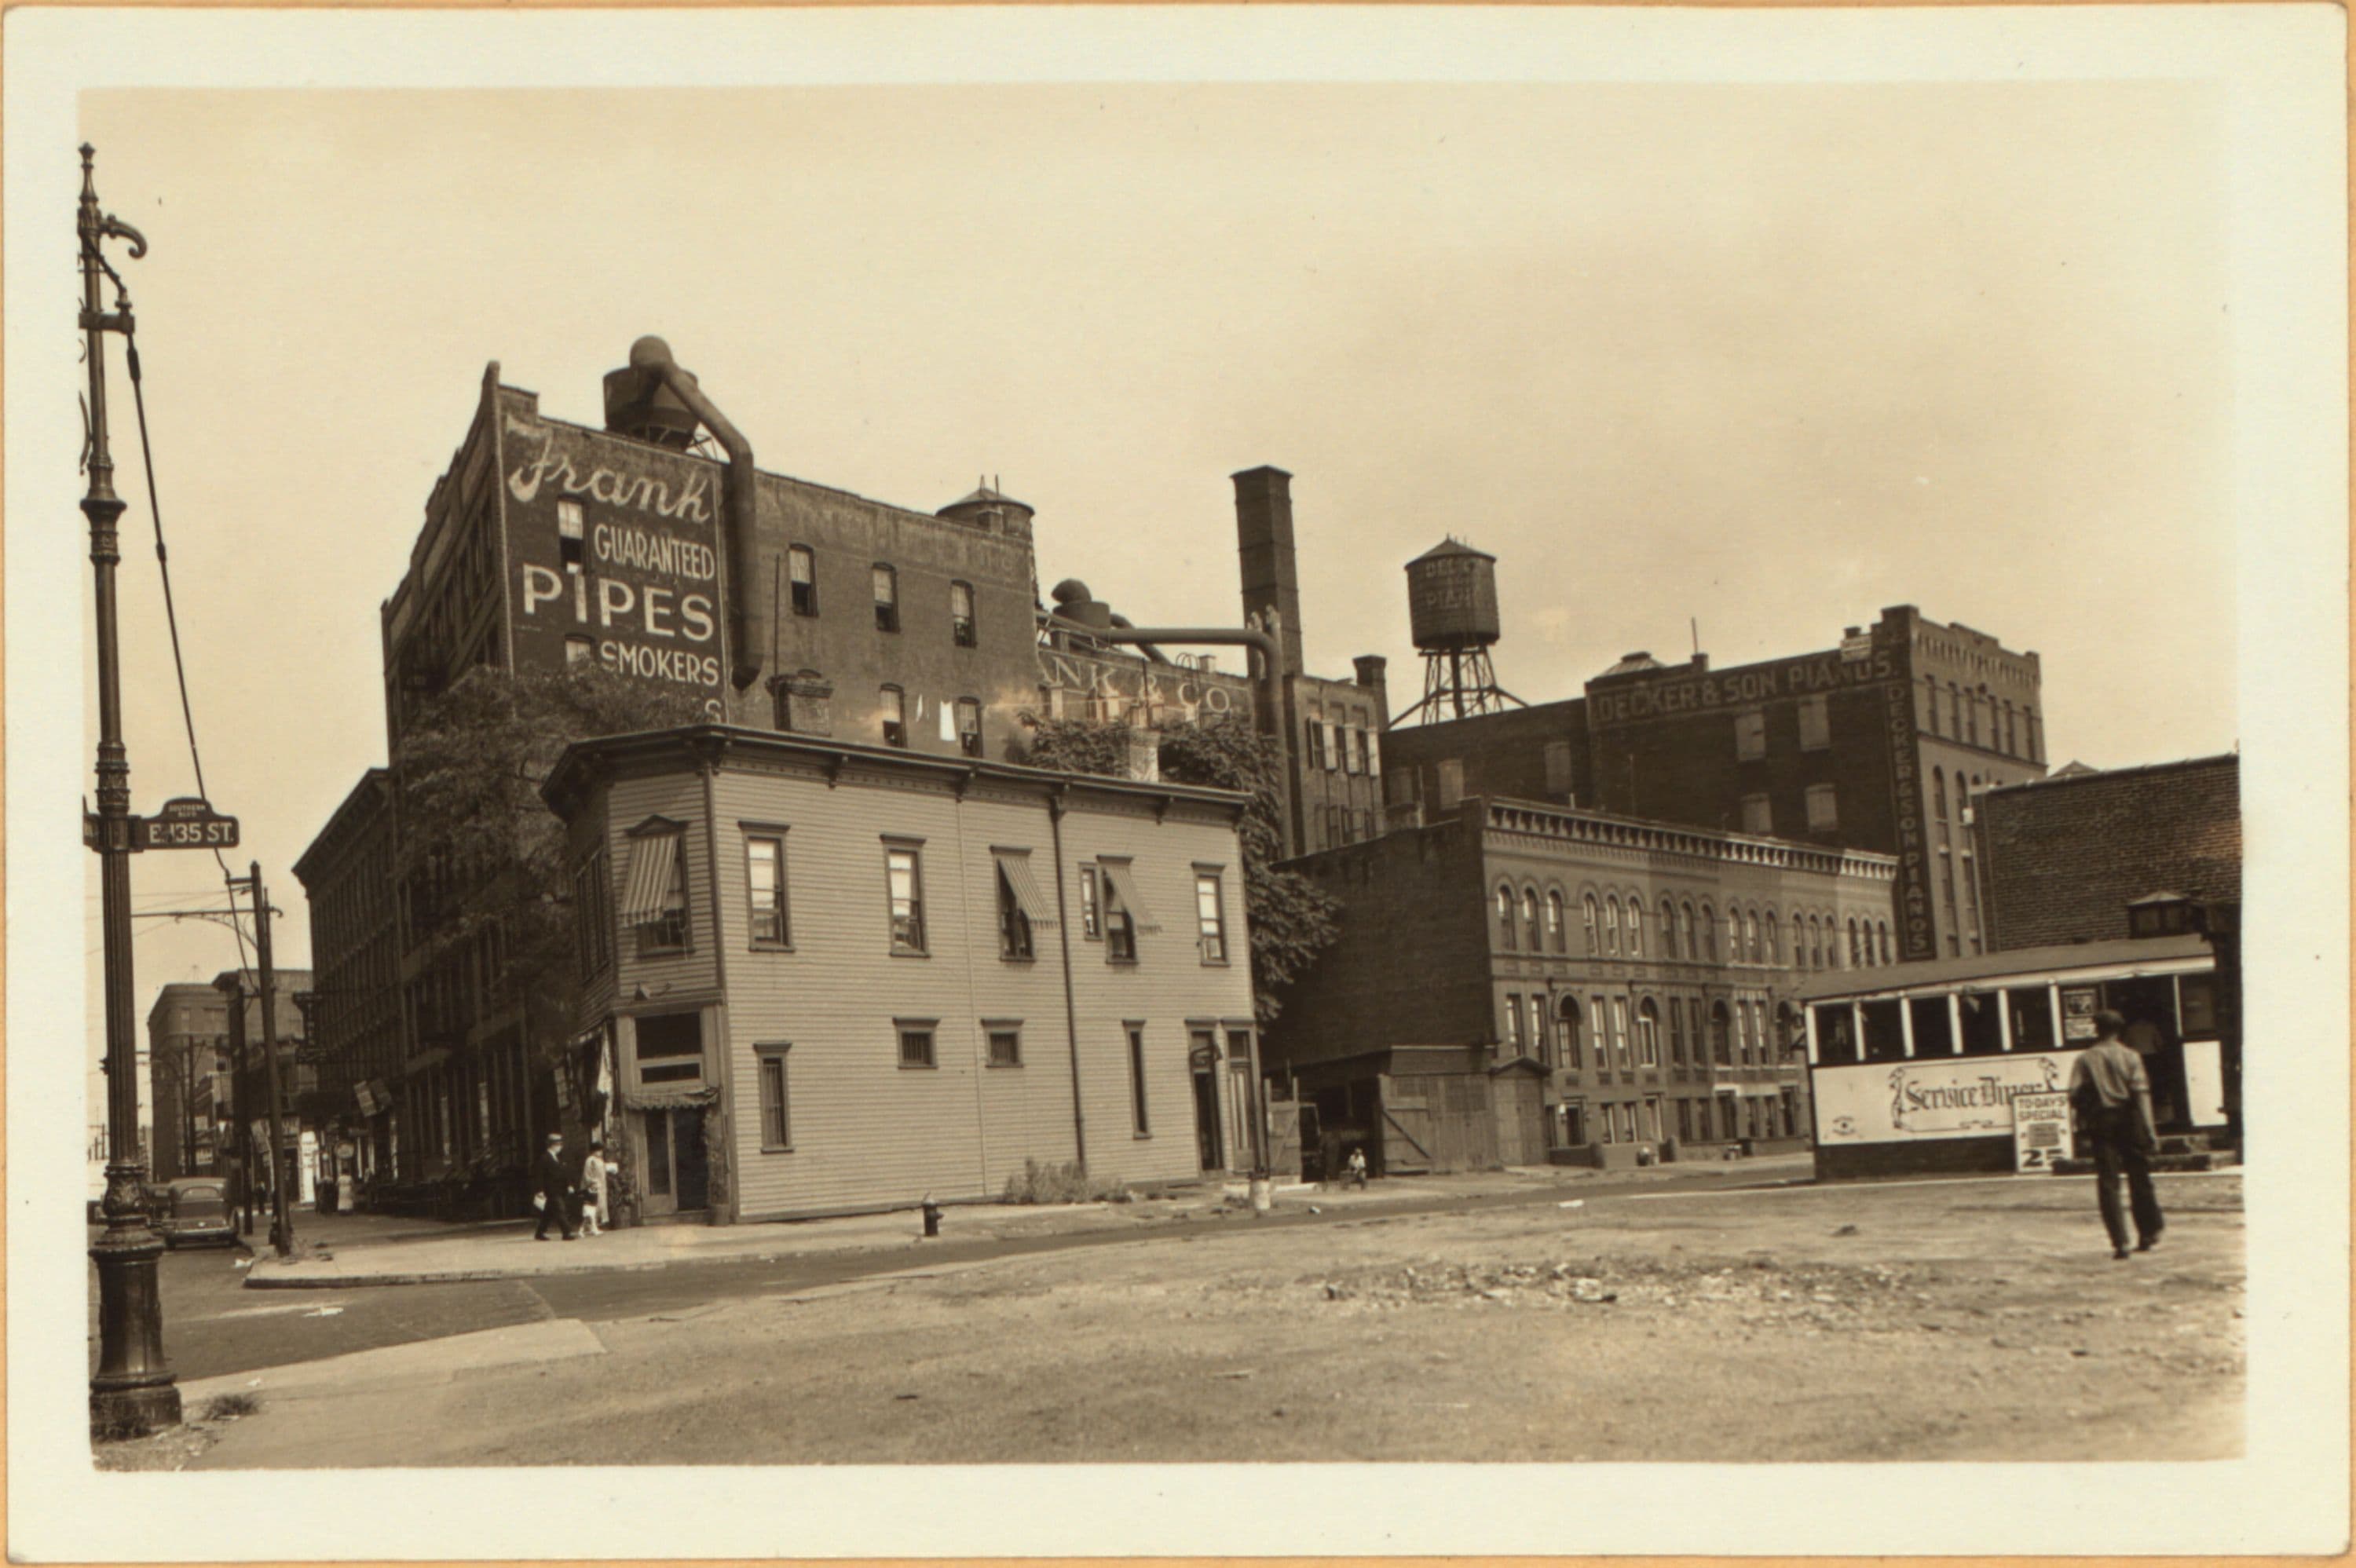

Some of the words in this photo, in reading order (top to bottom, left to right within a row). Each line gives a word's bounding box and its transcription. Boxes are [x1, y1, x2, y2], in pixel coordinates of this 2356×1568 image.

[507, 411, 710, 523] Frank
[594, 524, 715, 581] GUARANTEED
[522, 563, 715, 641] PIPES
[599, 640, 719, 686] SMOKERS
[1597, 682, 1698, 722] DECKER
[1701, 678, 1721, 705] &
[1724, 668, 1777, 703] SON
[1887, 685, 1912, 780] DECKER
[168, 822, 203, 844] 135
[206, 821, 234, 843] ST.
[1899, 799, 1918, 849] SON
[1905, 852, 1927, 952] PIANOS
[1905, 1080, 1977, 1112] Service
[2017, 1109, 2065, 1122] SPECIAL
